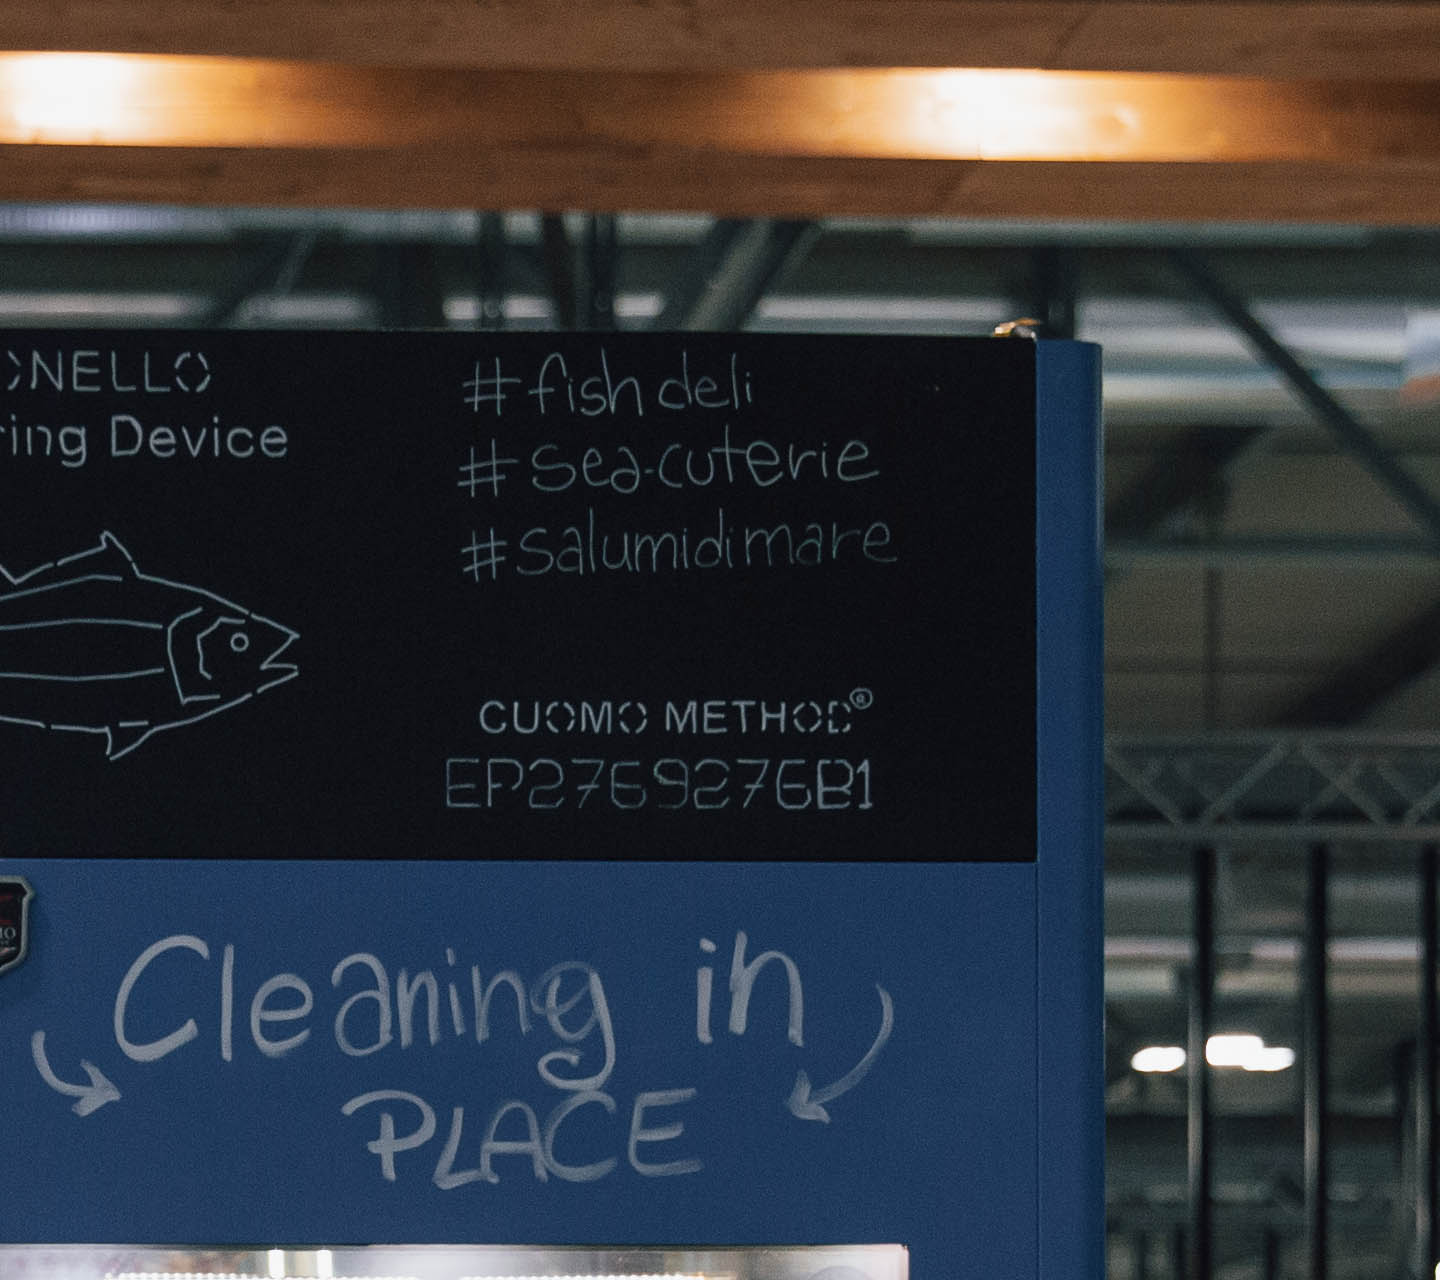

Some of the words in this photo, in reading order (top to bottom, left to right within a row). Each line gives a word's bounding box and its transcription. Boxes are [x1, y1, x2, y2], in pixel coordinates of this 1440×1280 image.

[110, 414, 290, 459] Device
[478, 700, 648, 735] CUOMO
[113, 932, 617, 1090] Cleaning
[694, 929, 806, 1048] in
[340, 1086, 704, 1190] PLACE
